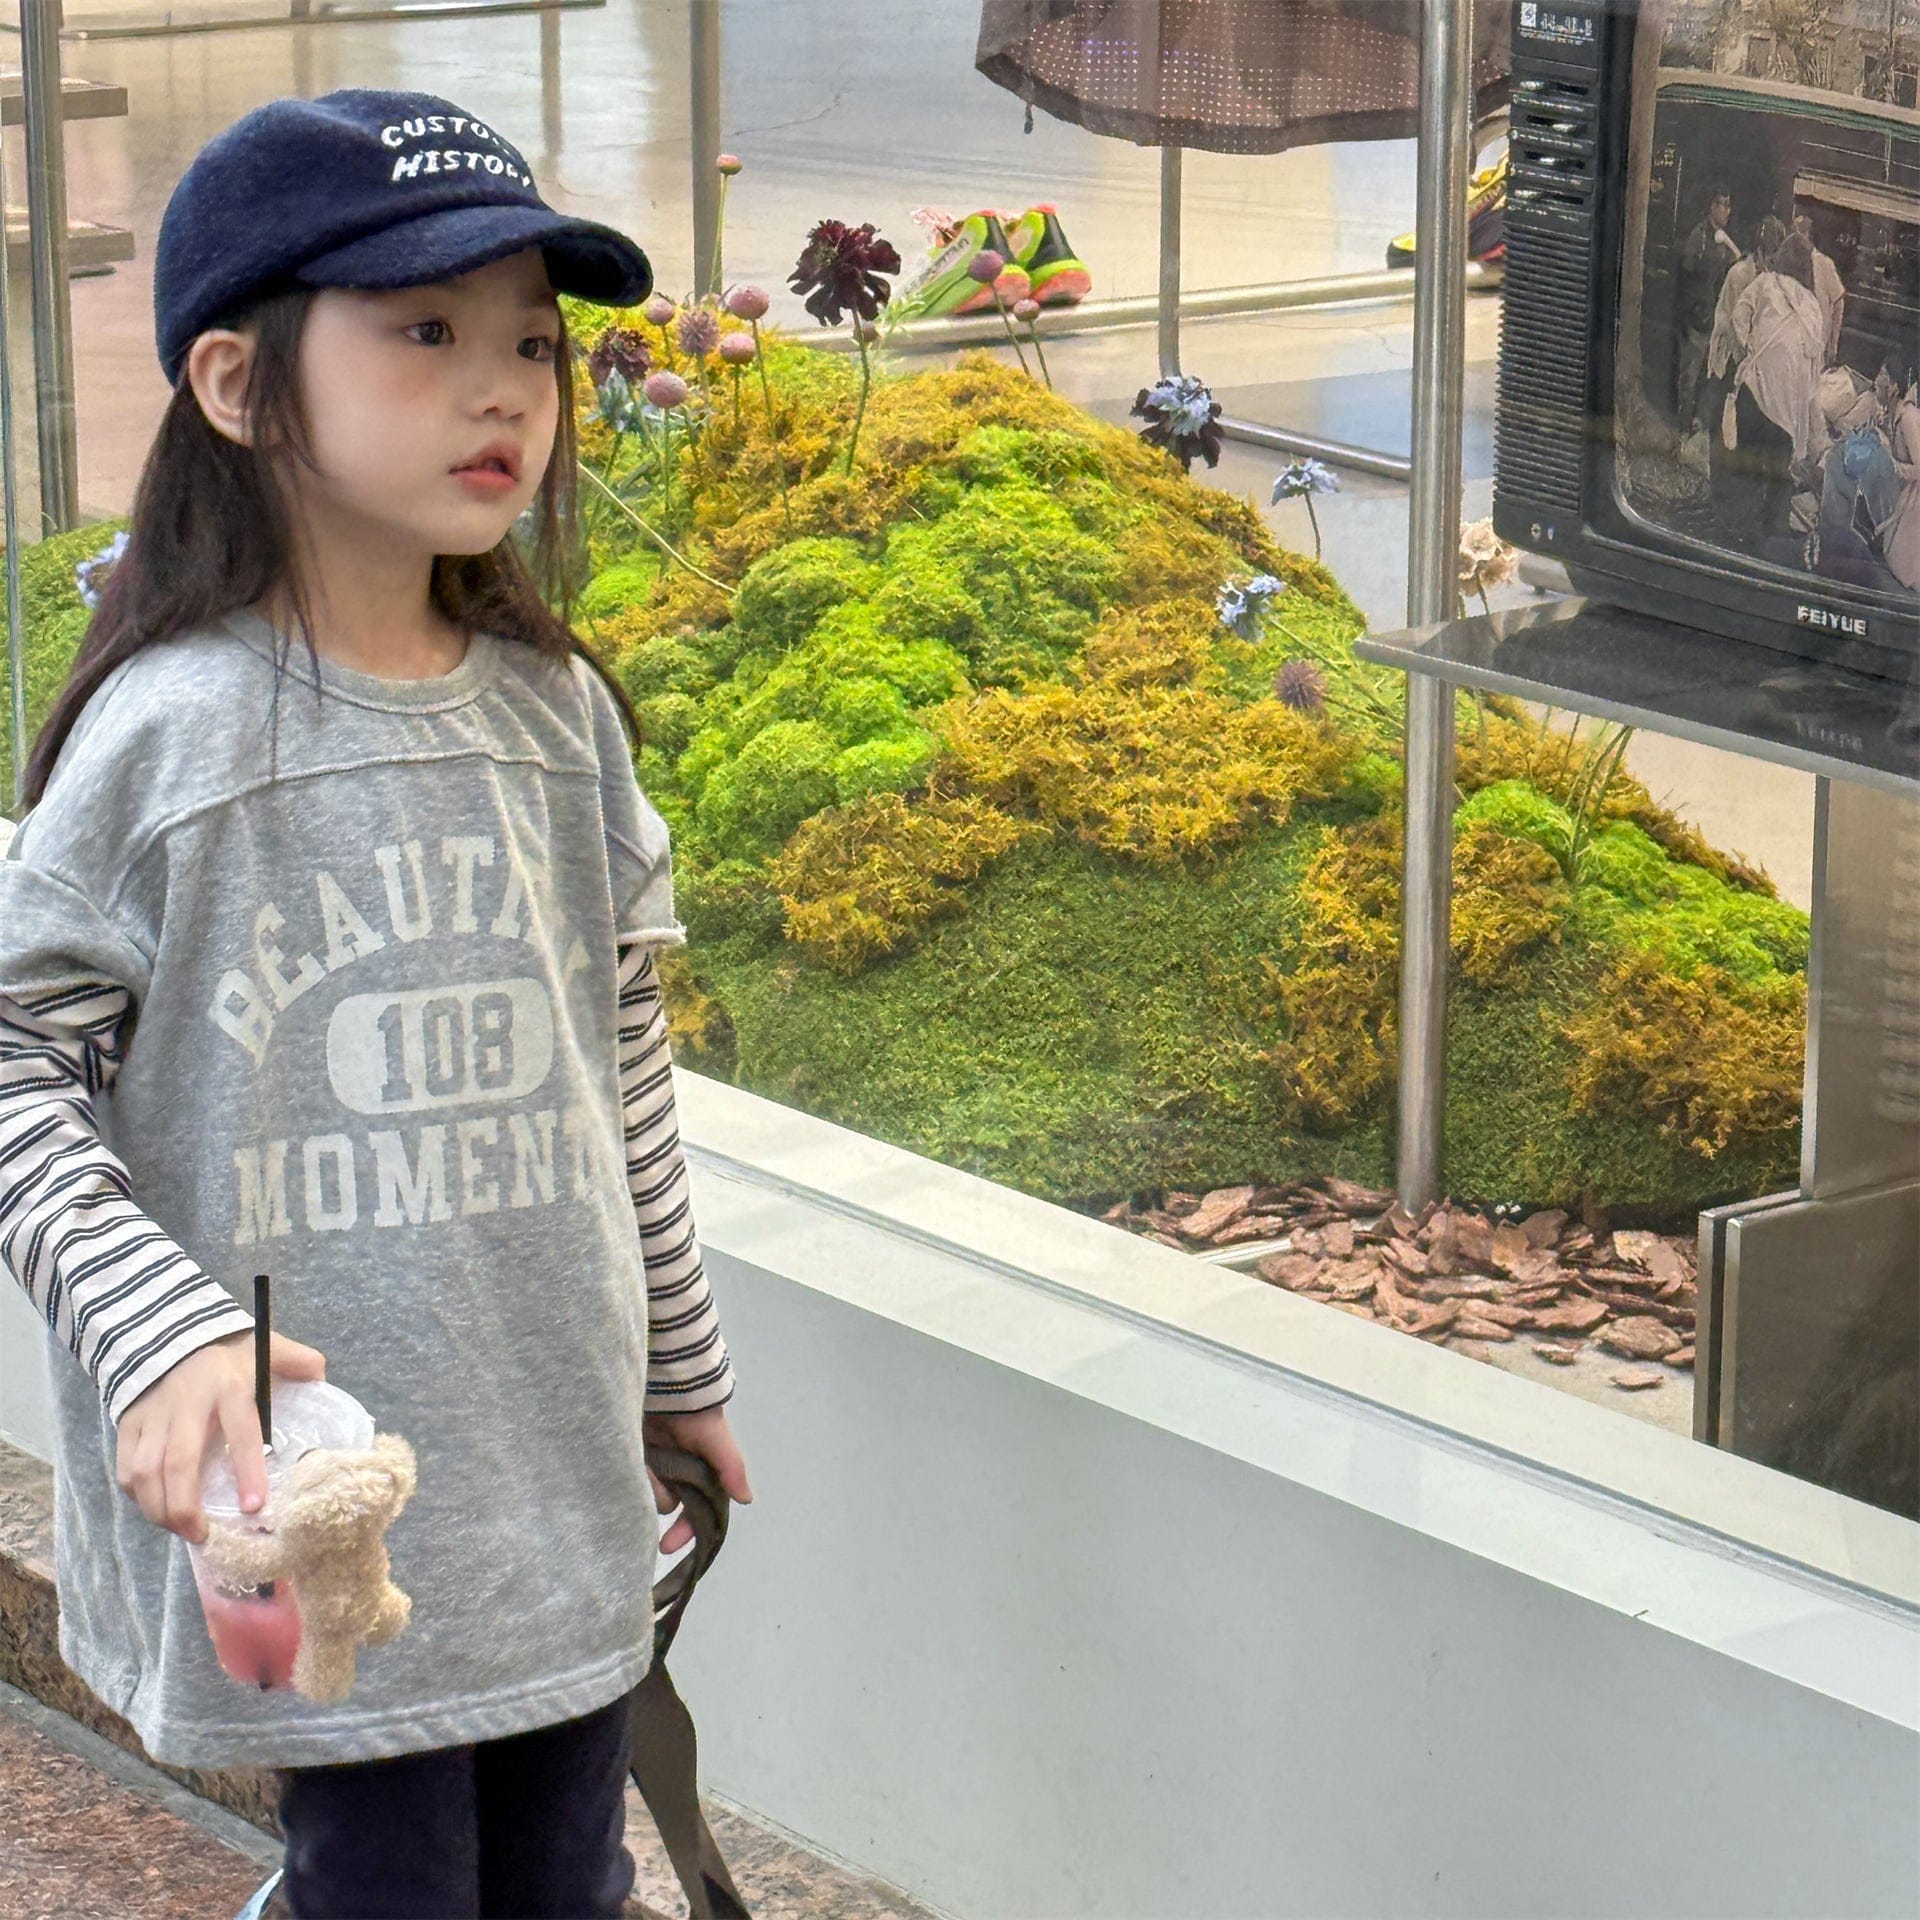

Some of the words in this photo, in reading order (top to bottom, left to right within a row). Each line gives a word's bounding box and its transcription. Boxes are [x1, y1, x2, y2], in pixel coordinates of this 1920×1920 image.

[381, 115, 513, 154] CUSTO
[1797, 605, 1867, 636] FEIYUE
[376, 992, 514, 1103] 108
